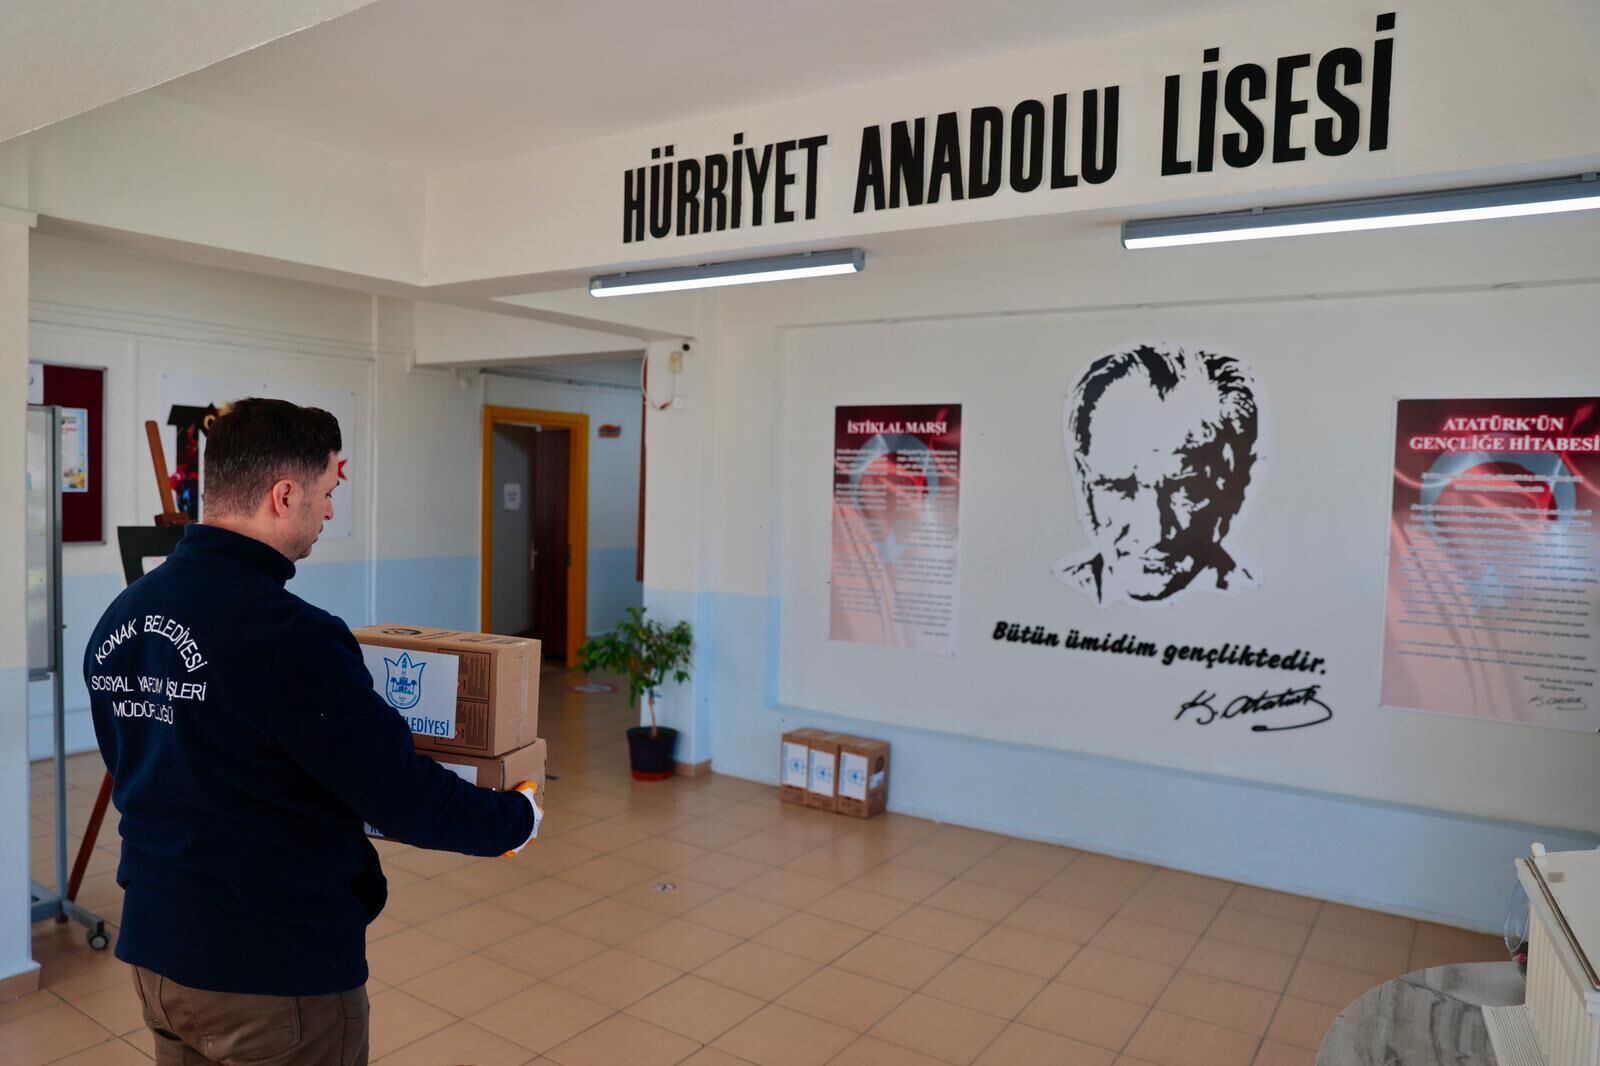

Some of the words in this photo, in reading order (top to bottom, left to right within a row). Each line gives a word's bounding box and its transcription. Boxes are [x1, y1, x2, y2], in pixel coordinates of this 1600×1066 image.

[623, 133, 828, 243] HÜRRİYET
[853, 85, 1119, 213] ANADOLU
[1161, 12, 1396, 176] LİSESİ
[847, 419, 904, 435] İSTİKLAL
[905, 421, 947, 436] MARŞI
[1443, 415, 1564, 431] ATATÜRK'ÜN
[1409, 435, 1504, 453] GENÇLİĞE
[1509, 435, 1600, 451] HİTABESİ
[95, 618, 138, 665] KONAK
[143, 615, 208, 673] BELEDİYESİ
[992, 621, 1059, 647] Bütün
[1065, 629, 1157, 657] ümidim
[1161, 643, 1327, 675] gençliktedir.
[91, 675, 134, 692] SOSYAL
[165, 677, 207, 701] İŞLERİ
[405, 716, 450, 737] EDİYESİ
